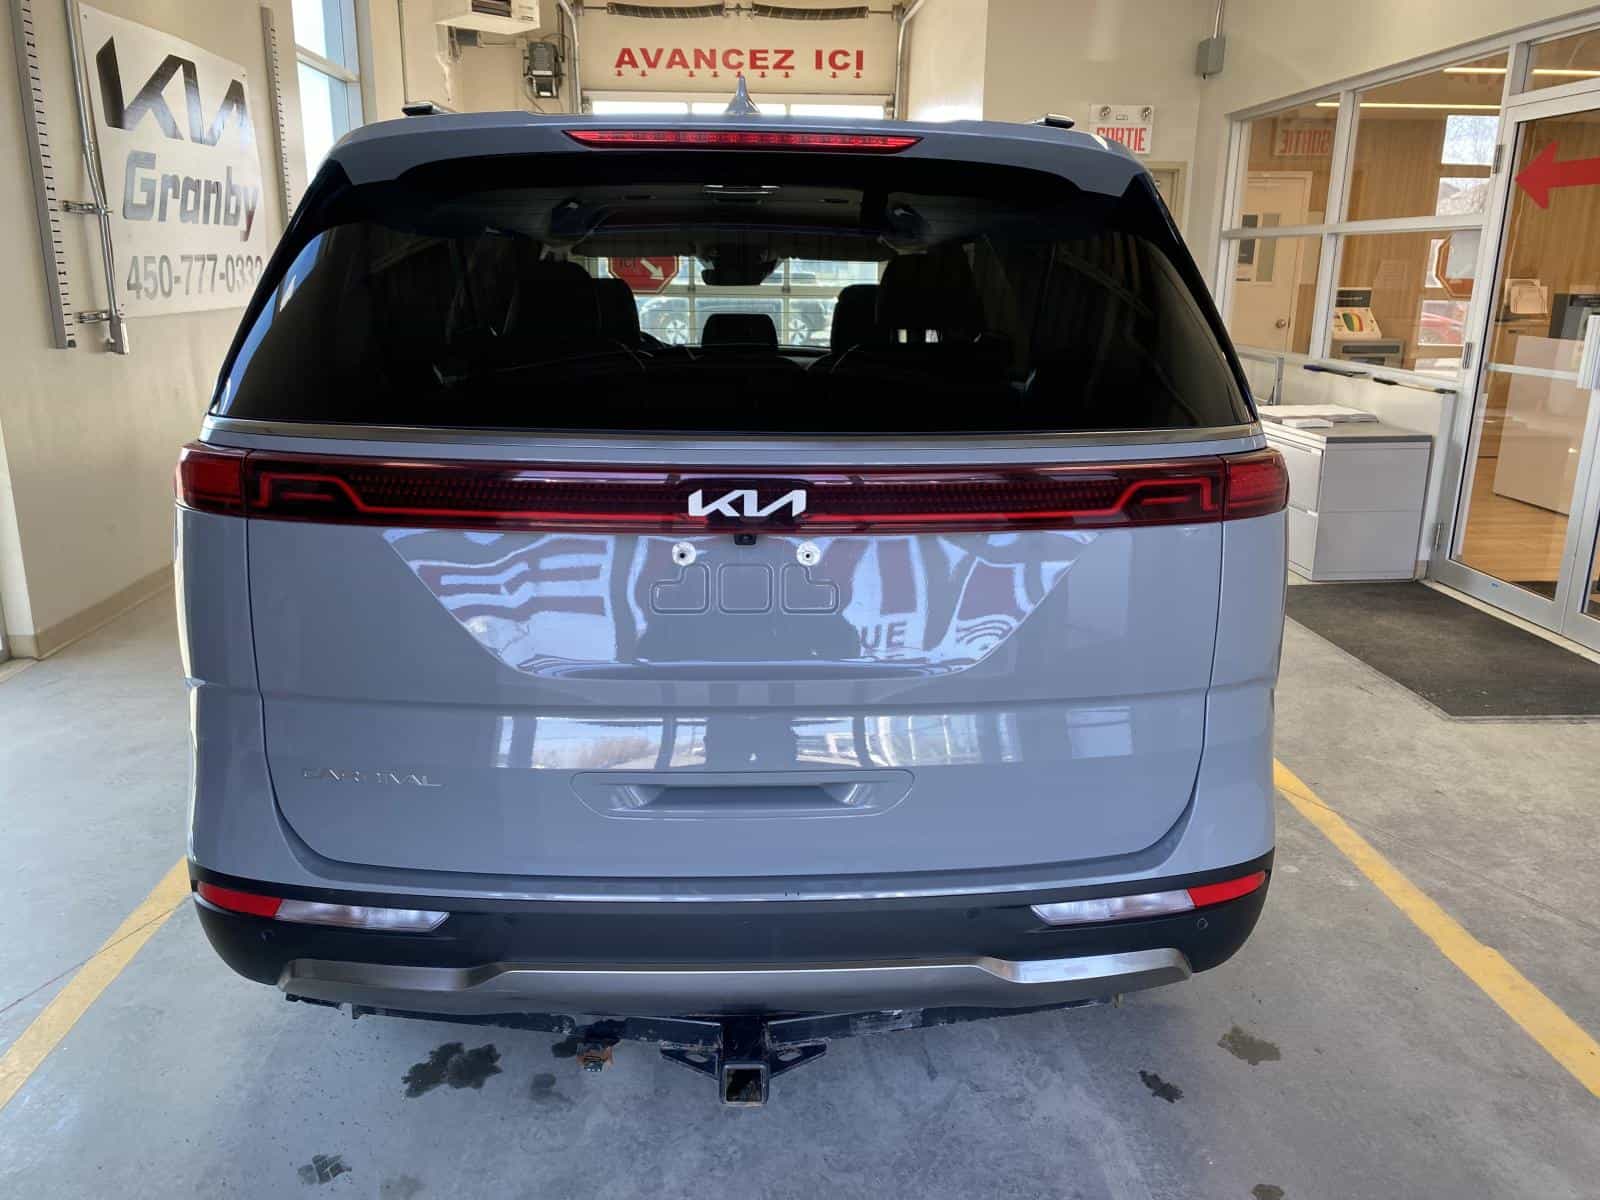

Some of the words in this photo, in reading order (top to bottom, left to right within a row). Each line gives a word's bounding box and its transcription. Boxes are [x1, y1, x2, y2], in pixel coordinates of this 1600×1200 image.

[614, 48, 794, 70] AVANCEZ
[815, 49, 864, 70] ICI
[96, 35, 251, 146] KIA
[123, 150, 259, 242] Granby
[688, 489, 807, 517] KIA
